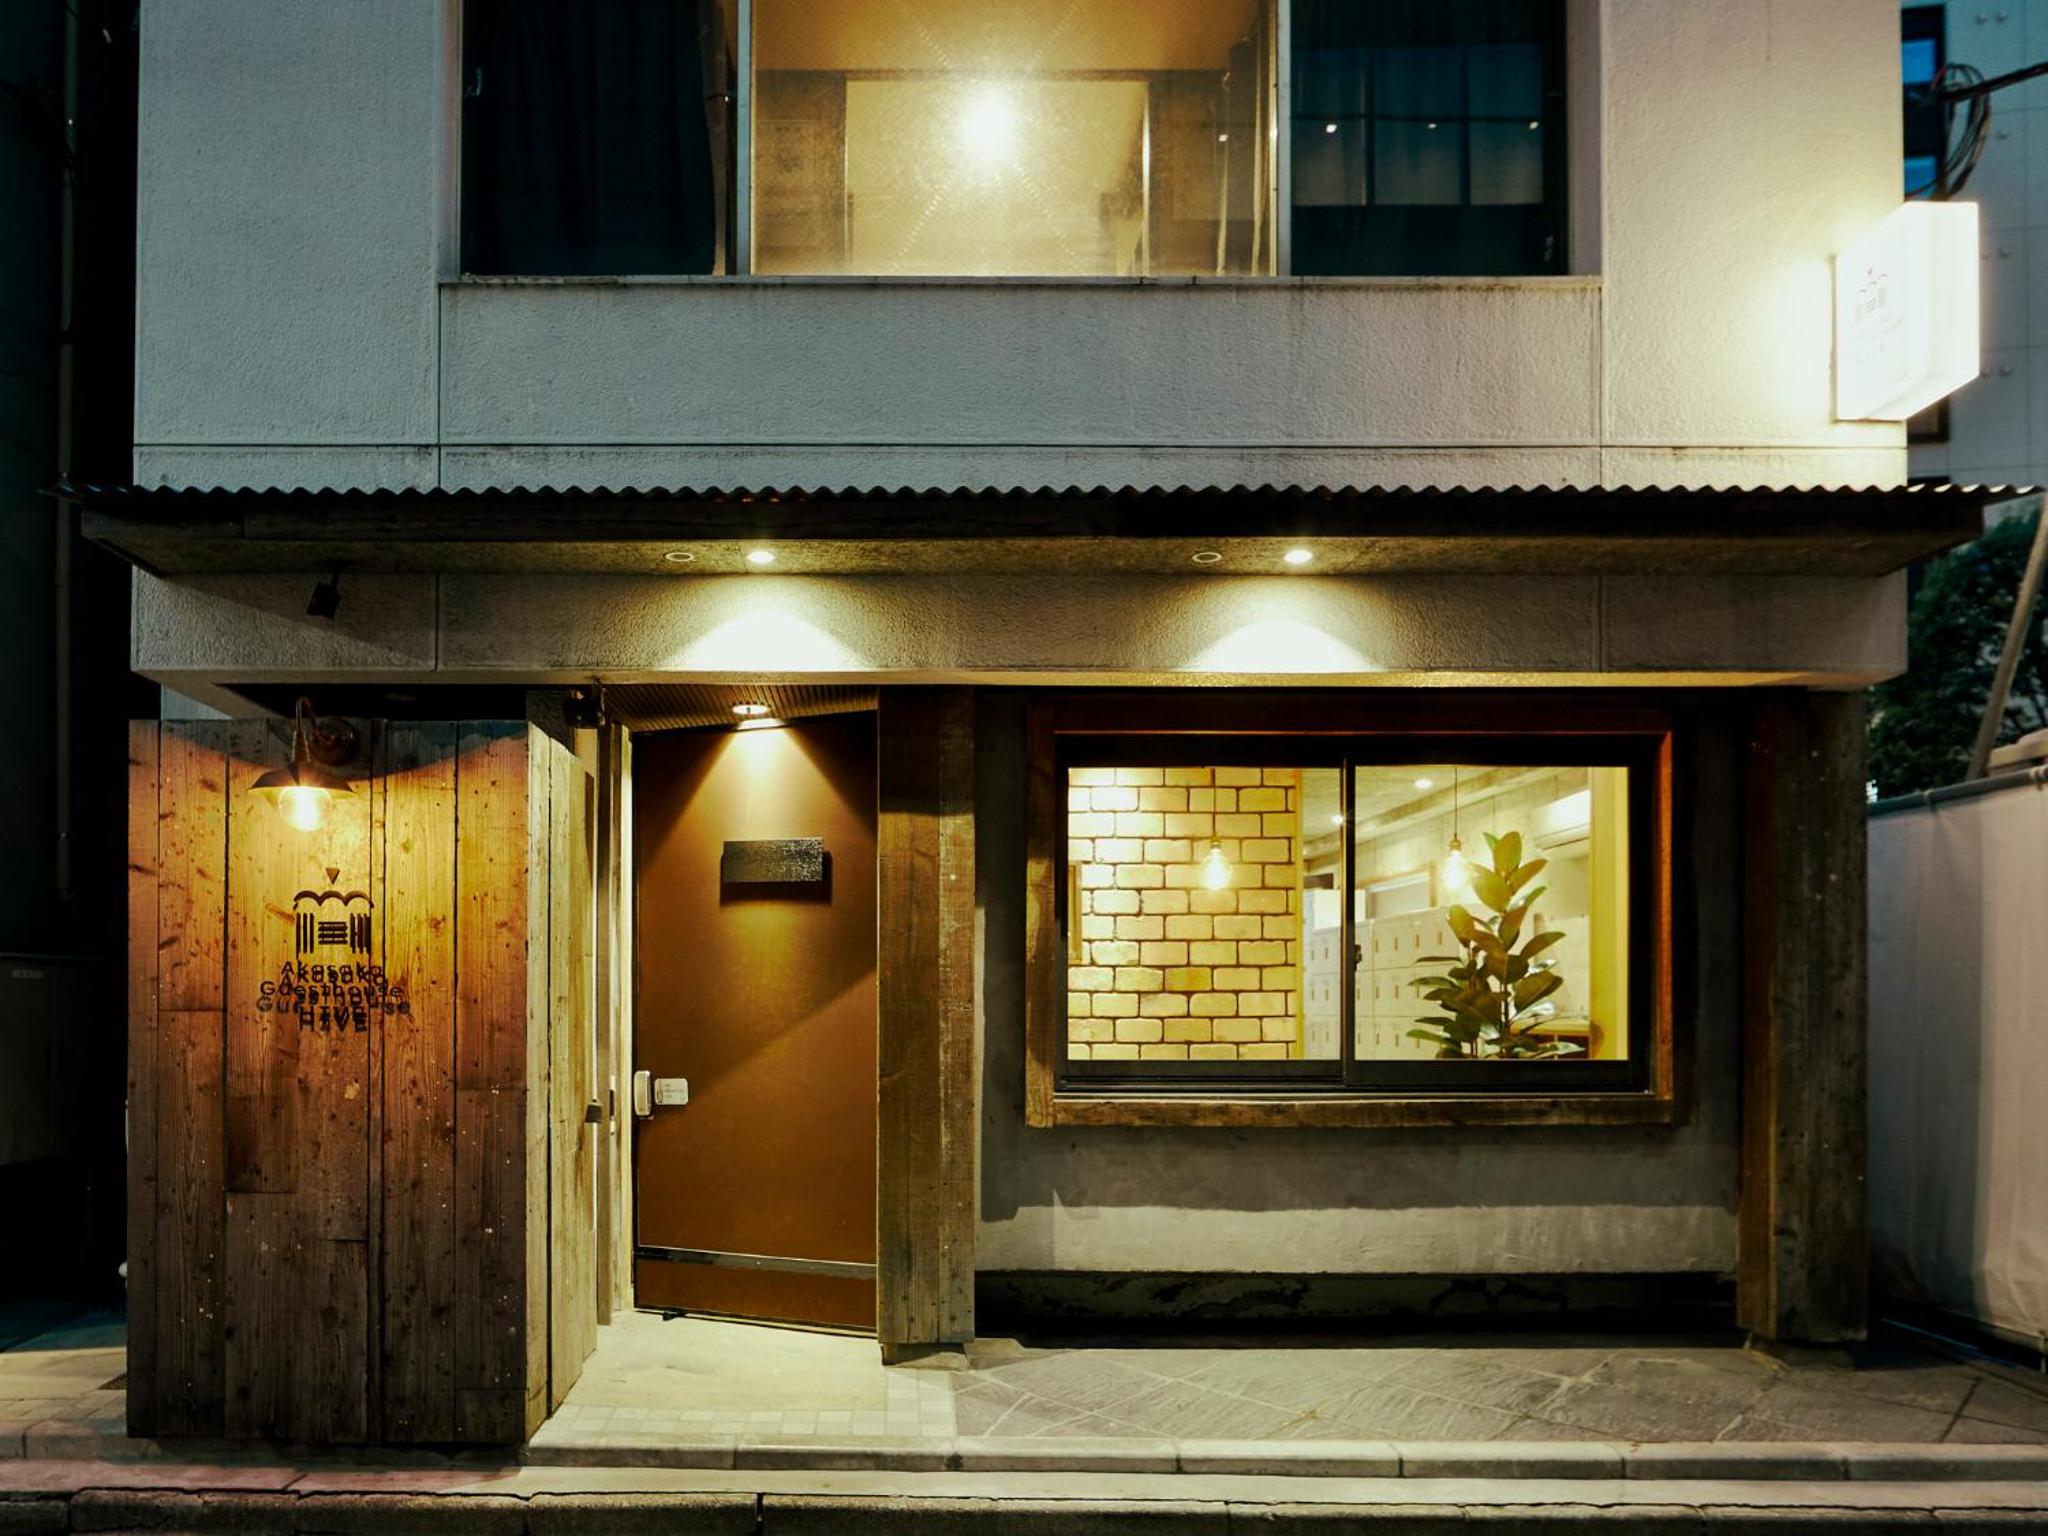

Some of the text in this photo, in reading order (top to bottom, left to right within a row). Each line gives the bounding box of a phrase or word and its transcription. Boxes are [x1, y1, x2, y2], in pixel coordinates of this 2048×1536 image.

[281, 961, 383, 978] Akasaka
[260, 979, 403, 998] Guesthouse
[300, 1006, 367, 1029] HIVE
